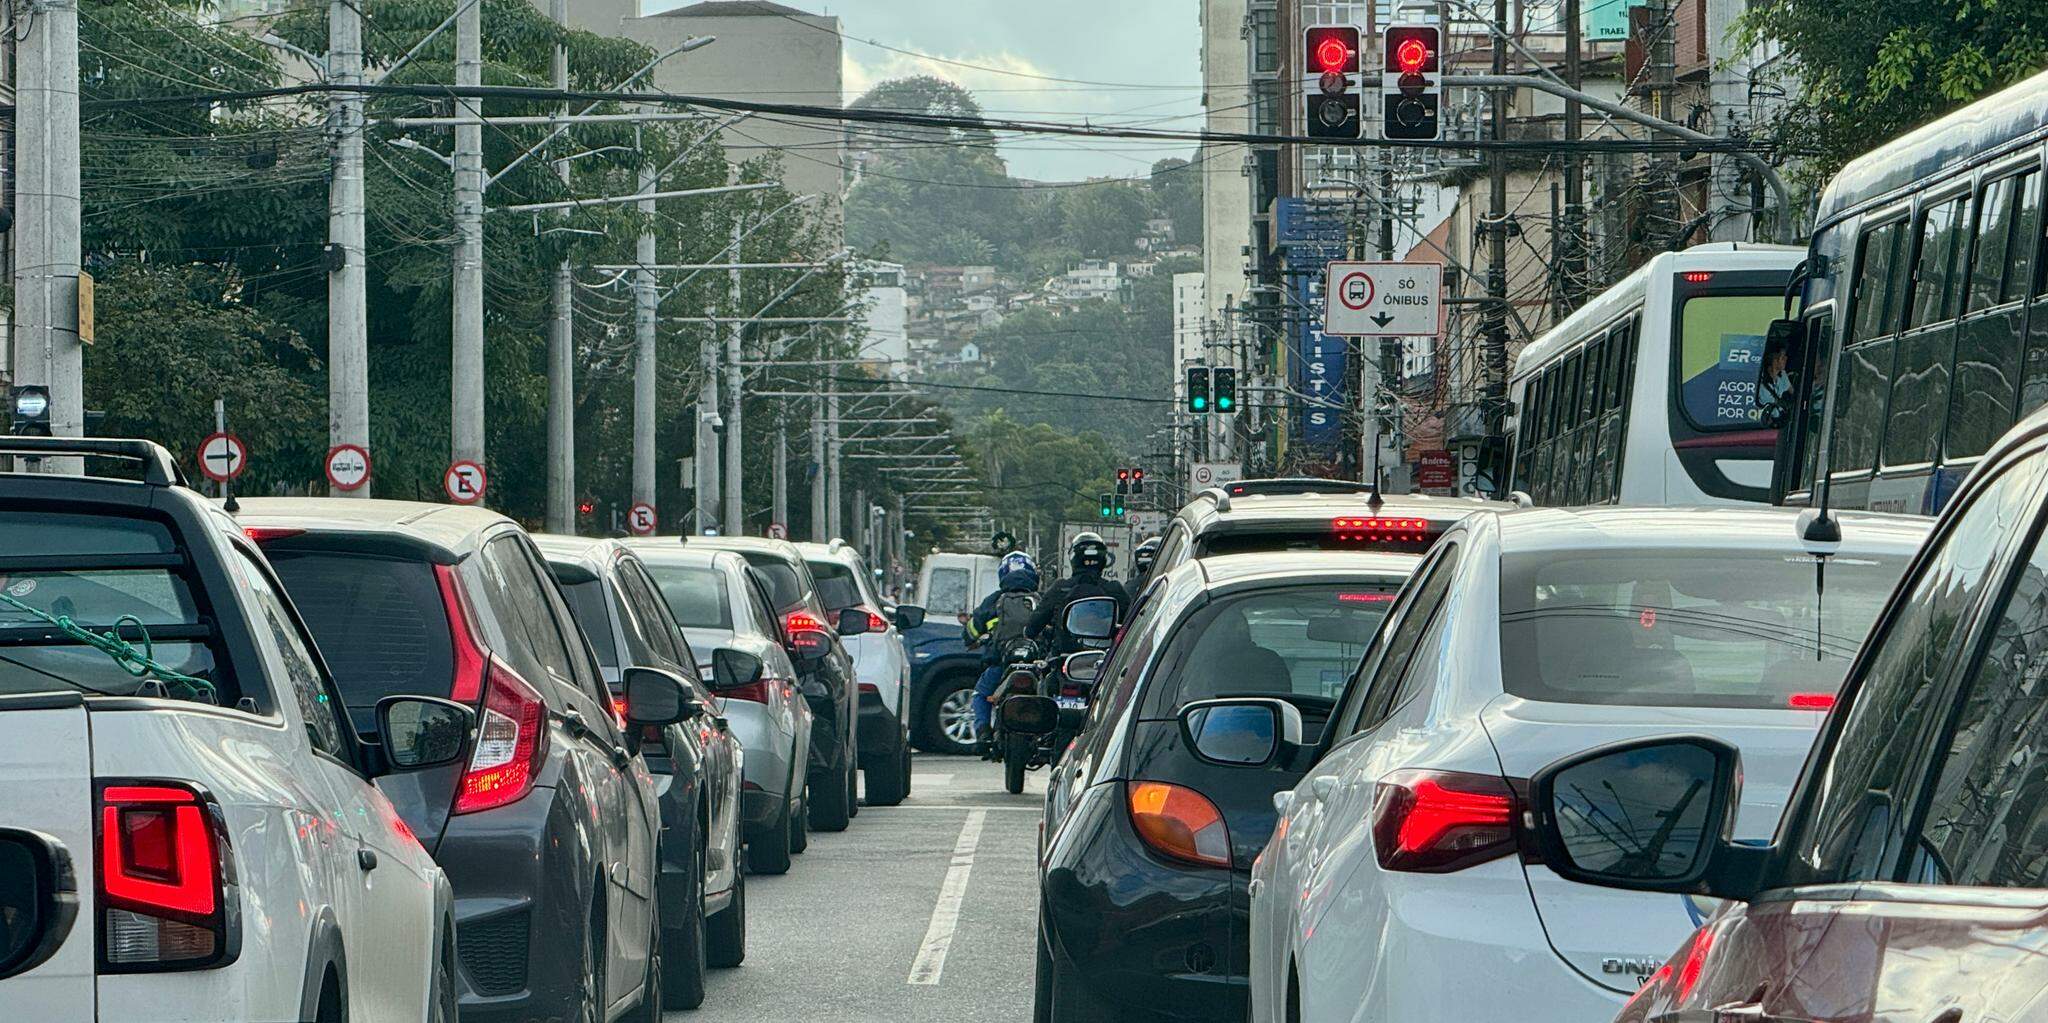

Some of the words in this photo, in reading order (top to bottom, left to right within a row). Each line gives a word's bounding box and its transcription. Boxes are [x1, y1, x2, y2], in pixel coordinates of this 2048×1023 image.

[1398, 276, 1415, 289] SÓ
[1383, 293, 1429, 306] ÔNIBUS
[1718, 381, 1756, 393] AGOR
[1718, 394, 1742, 405] FAZ
[1717, 407, 1744, 419] POR
[458, 472, 472, 493] E
